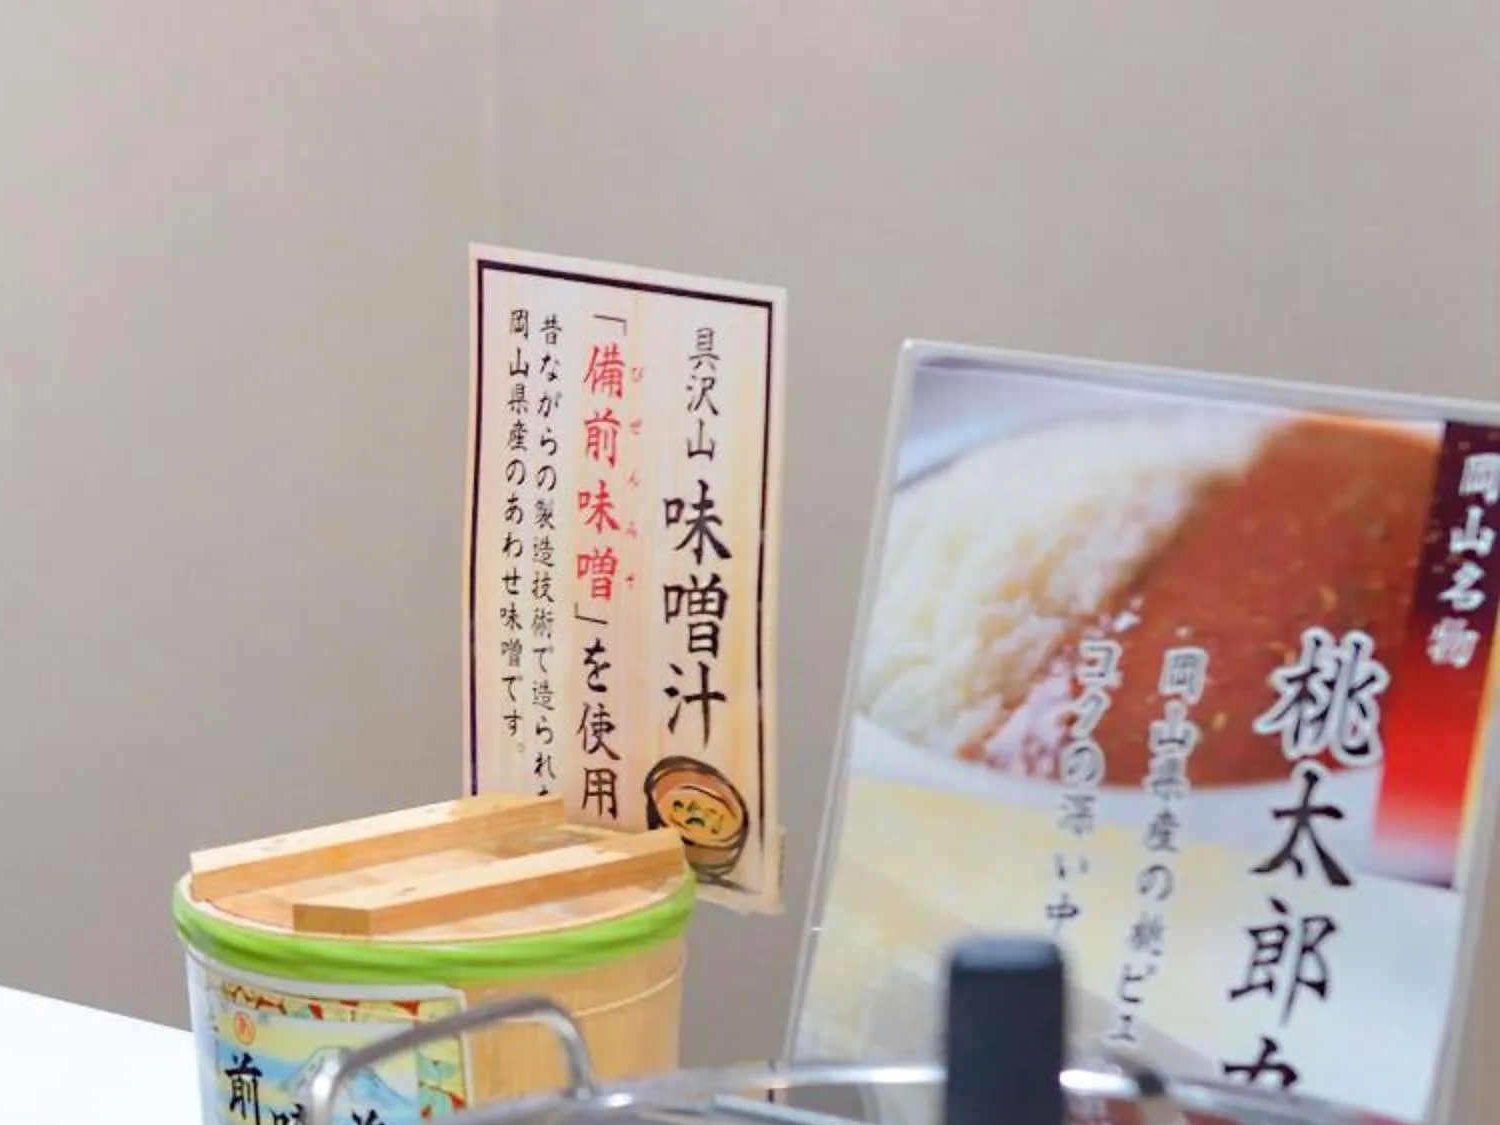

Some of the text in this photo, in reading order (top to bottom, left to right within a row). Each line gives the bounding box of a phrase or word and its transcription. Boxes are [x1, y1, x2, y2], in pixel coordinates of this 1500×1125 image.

[530, 313, 562, 796] 昔ながらの製造技術で造られ
